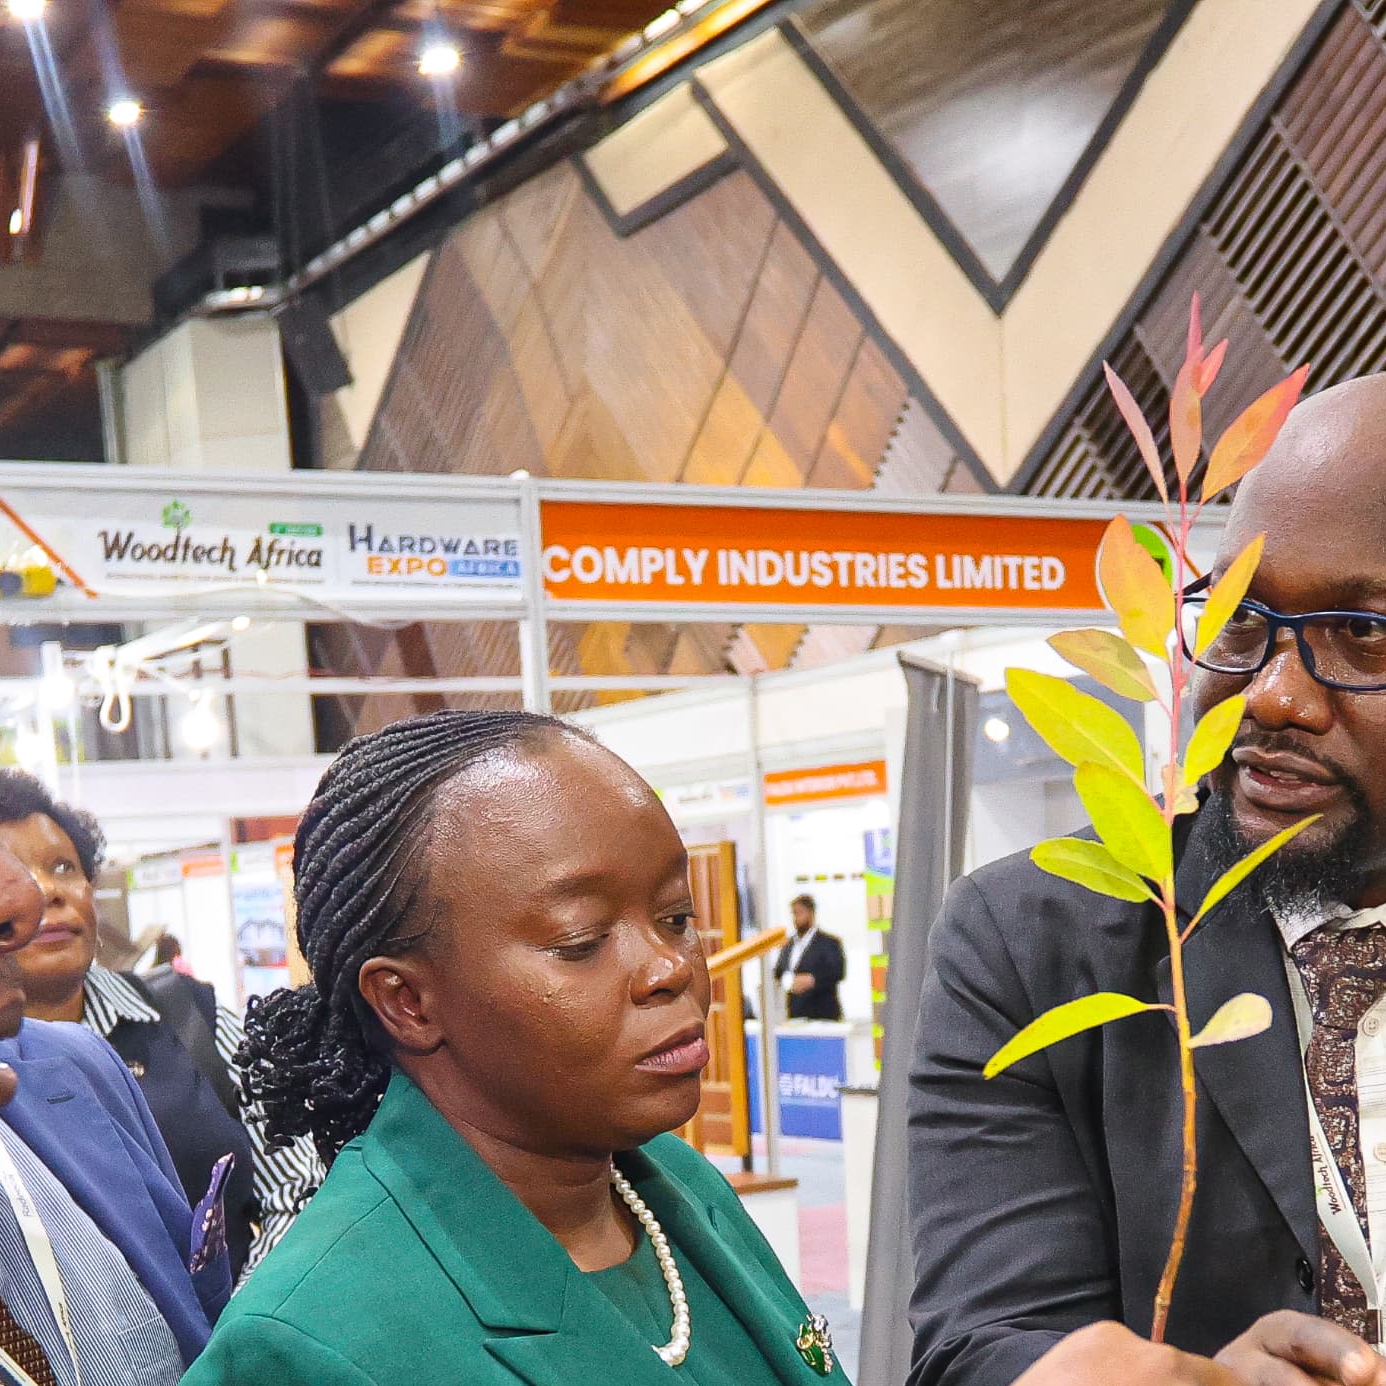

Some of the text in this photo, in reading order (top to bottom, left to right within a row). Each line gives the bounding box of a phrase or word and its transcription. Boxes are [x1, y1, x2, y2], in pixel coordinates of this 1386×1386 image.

[97, 527, 324, 572] Woodtech Africa
[347, 523, 519, 557] HARDWARE
[367, 555, 448, 577] EXPO
[543, 544, 1067, 591] COMPLY INDUSTRIES LIMITED
[1317, 1163, 1342, 1215] Woodtech
